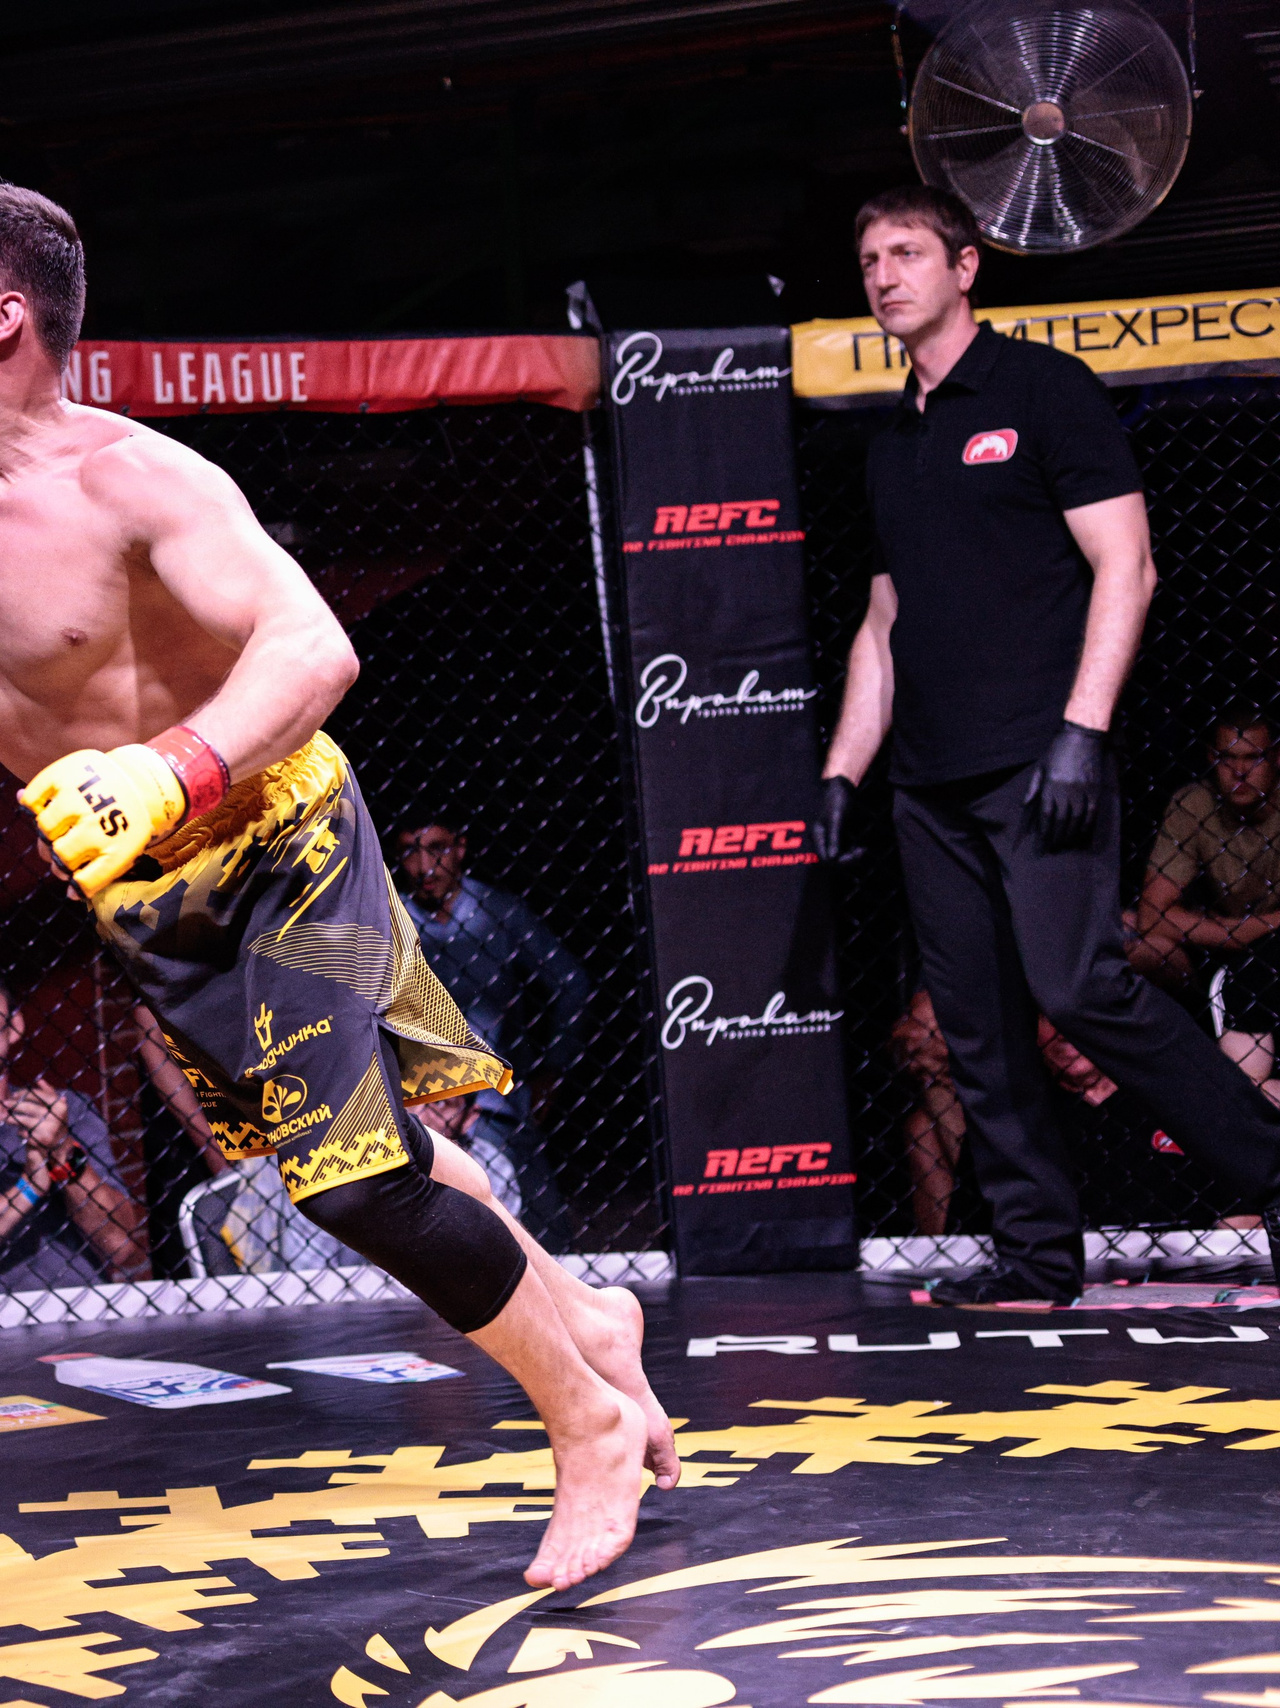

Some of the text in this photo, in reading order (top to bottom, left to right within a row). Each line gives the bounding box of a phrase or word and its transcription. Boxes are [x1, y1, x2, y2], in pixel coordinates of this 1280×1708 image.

[152, 352, 308, 404] LEAGUE
[77, 764, 129, 837] SFL
[267, 1103, 333, 1144] НОВСКИЙ
[687, 1325, 1280, 1358] RUTU
